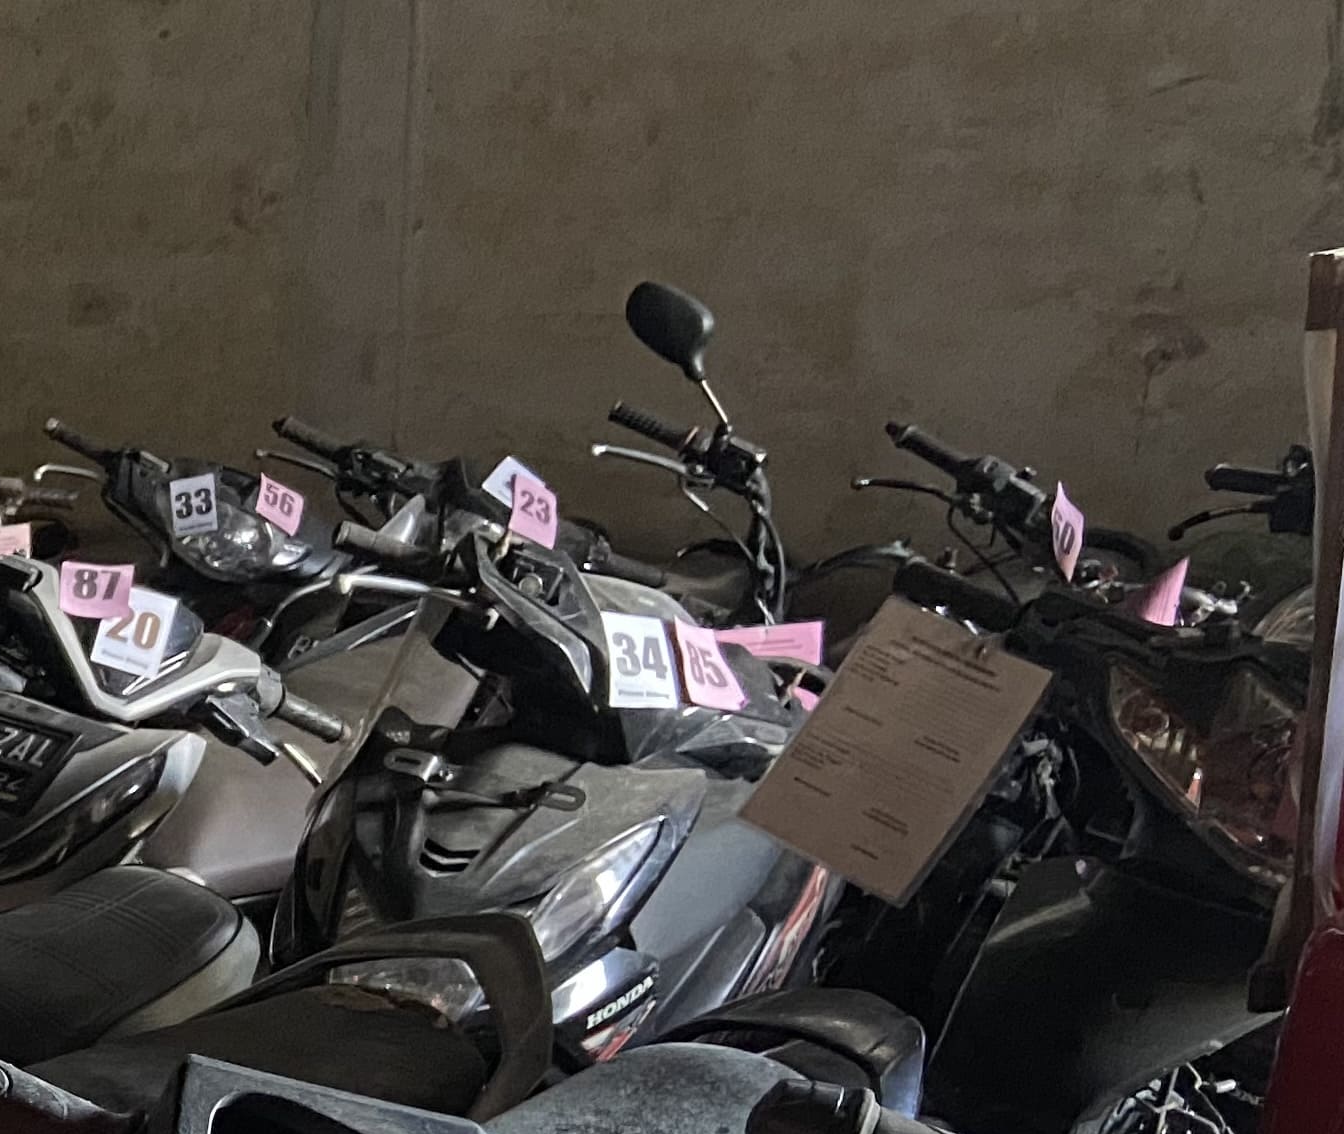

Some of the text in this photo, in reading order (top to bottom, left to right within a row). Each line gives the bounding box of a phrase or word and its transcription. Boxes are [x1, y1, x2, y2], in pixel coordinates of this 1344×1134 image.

[174, 487, 212, 520] 33
[263, 483, 295, 517] 56
[519, 490, 552, 521] 23
[72, 567, 123, 602] 87
[104, 609, 161, 654] 20
[612, 630, 668, 681] 34
[686, 640, 725, 690] 85
[585, 975, 655, 1031] HONDA
